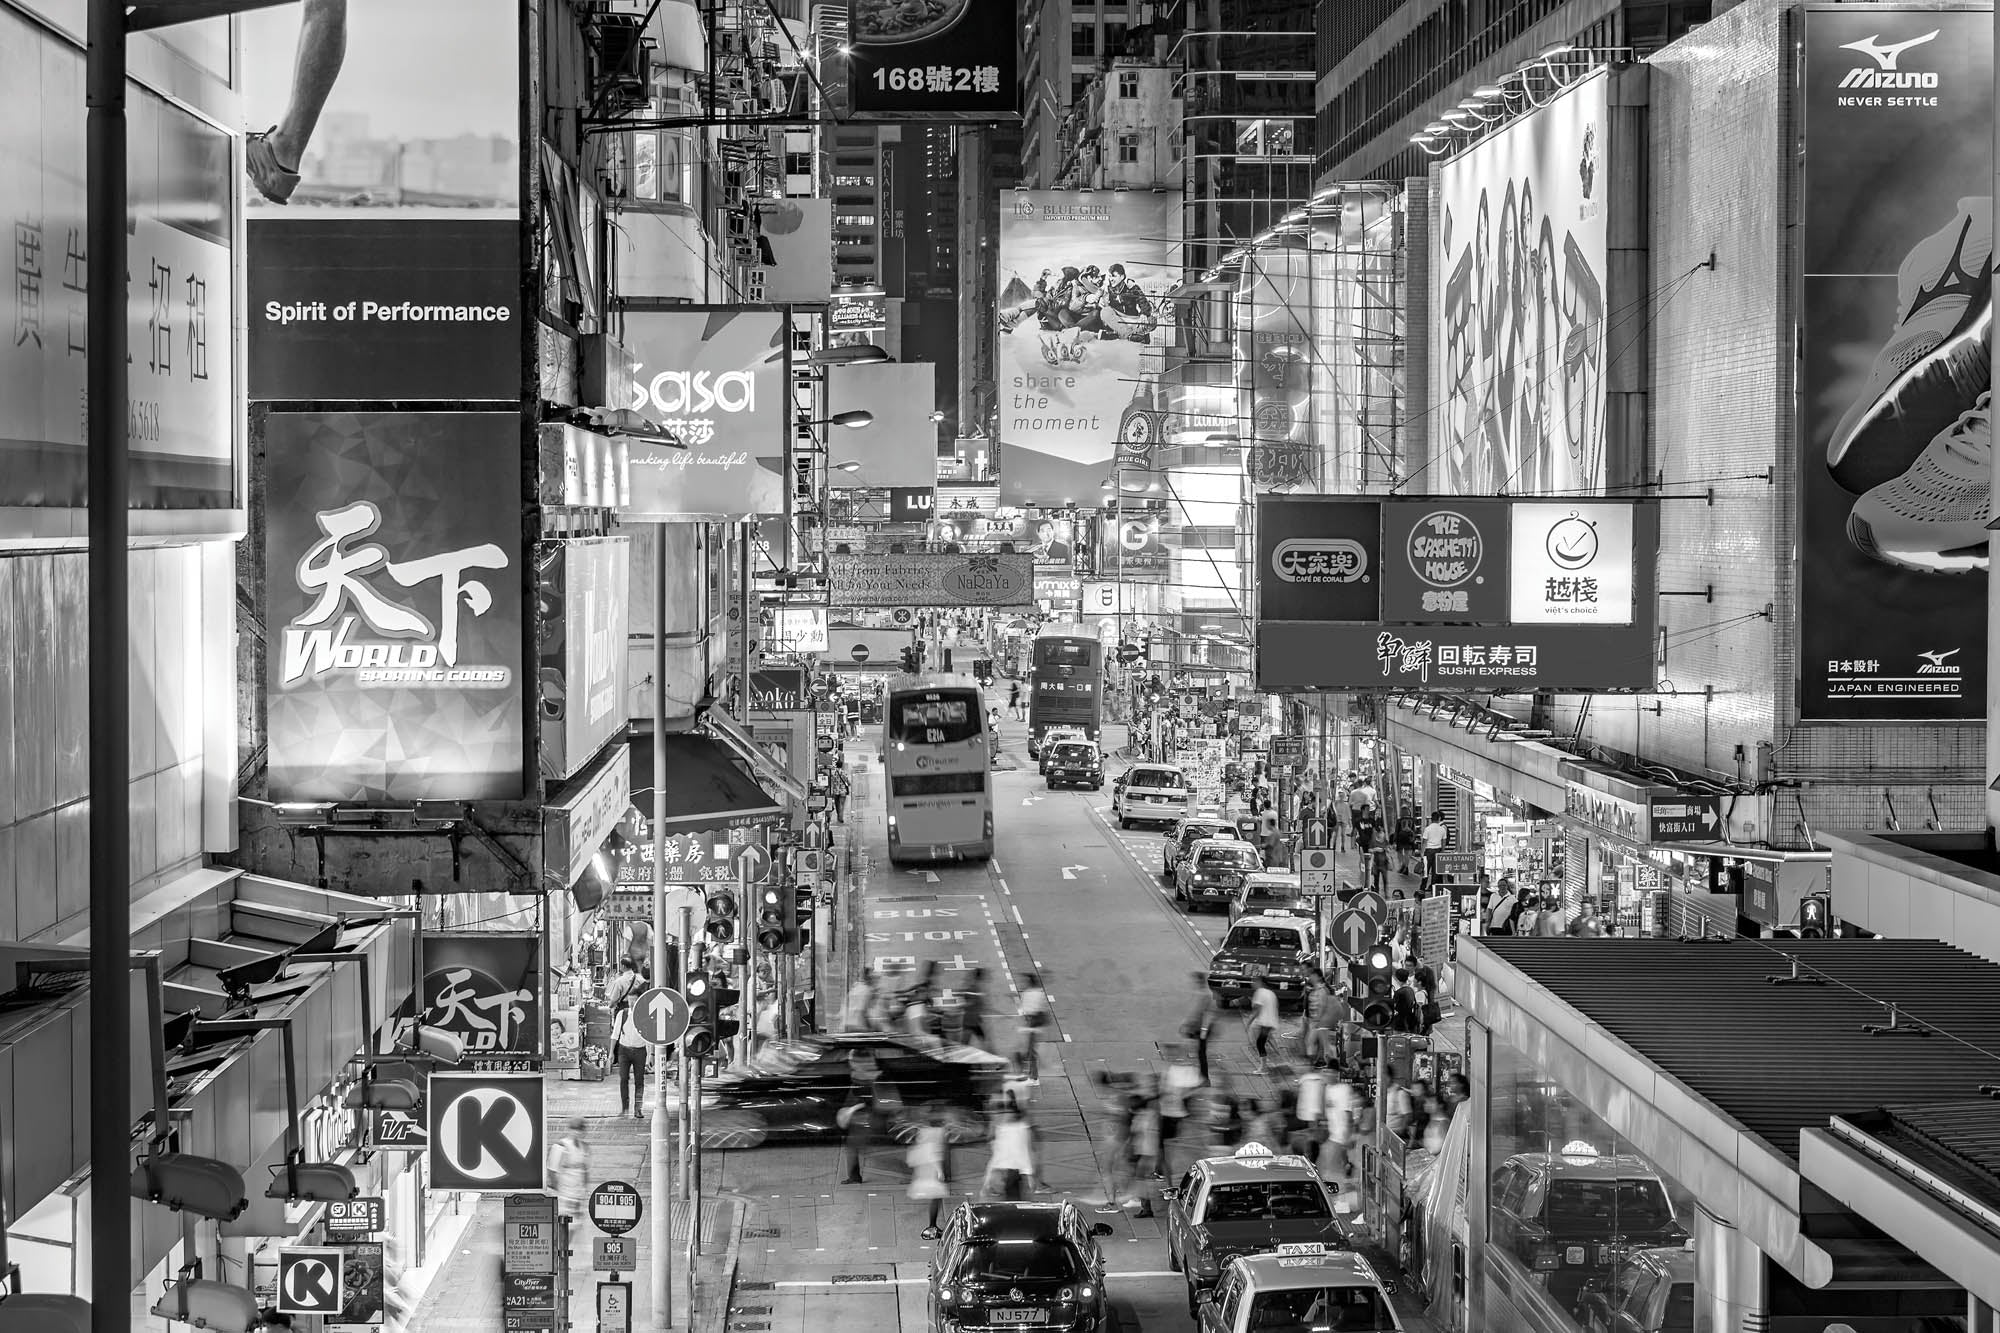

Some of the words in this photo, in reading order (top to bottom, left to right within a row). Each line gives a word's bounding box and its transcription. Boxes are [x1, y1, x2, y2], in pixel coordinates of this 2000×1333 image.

[873, 65, 999, 92] 168號2樓
[1838, 97, 1882, 106] NEVER
[1888, 97, 1938, 106] SETTLE
[1043, 205, 1076, 215] BLUE
[1079, 205, 1111, 215] GIRL
[265, 301, 327, 325] Spirit
[333, 301, 356, 321] of
[363, 301, 510, 321] Performance
[1014, 373, 1076, 388] share
[1014, 394, 1048, 409] the
[1013, 416, 1100, 430] moment
[630, 451, 669, 470] making
[672, 452, 694, 470] life
[697, 451, 748, 470] beautiful
[1134, 457, 1149, 467] GIRL
[1427, 515, 1460, 535] THE
[1285, 551, 1353, 575] 大家樂
[851, 564, 881, 577] from
[884, 564, 930, 575] Fabrics
[1425, 561, 1468, 581] HOUSE
[865, 579, 891, 590] Your
[896, 579, 930, 590] Needs
[957, 574, 1009, 590] NaRaYa
[1296, 575, 1312, 583] CAFÉ
[295, 505, 509, 668] 天下
[1545, 576, 1598, 603] 越棧
[285, 617, 437, 684] WORLD
[1438, 645, 1537, 666] 回転寿司
[1438, 667, 1476, 676] SUSHI
[1479, 667, 1537, 676] EXPRESS
[1828, 660, 1880, 673] 日本設計
[358, 670, 444, 682] SPORTING
[447, 670, 505, 682] GOODS
[1828, 684, 1872, 692] JAPAN
[1877, 684, 1960, 692] ENGINEERED
[1322, 873, 1328, 881] 7
[1322, 884, 1332, 893] 12
[874, 908, 959, 919] BUS
[864, 930, 979, 942] STOP
[434, 968, 534, 1050] 天下
[457, 1096, 527, 1172] K
[599, 1195, 614, 1205] 904
[619, 1195, 634, 1206] 905
[520, 1224, 538, 1238] E21A
[606, 1243, 621, 1254] 905
[1282, 1244, 1322, 1254] TAXI
[293, 1262, 332, 1303] K
[507, 1318, 520, 1328] E21
